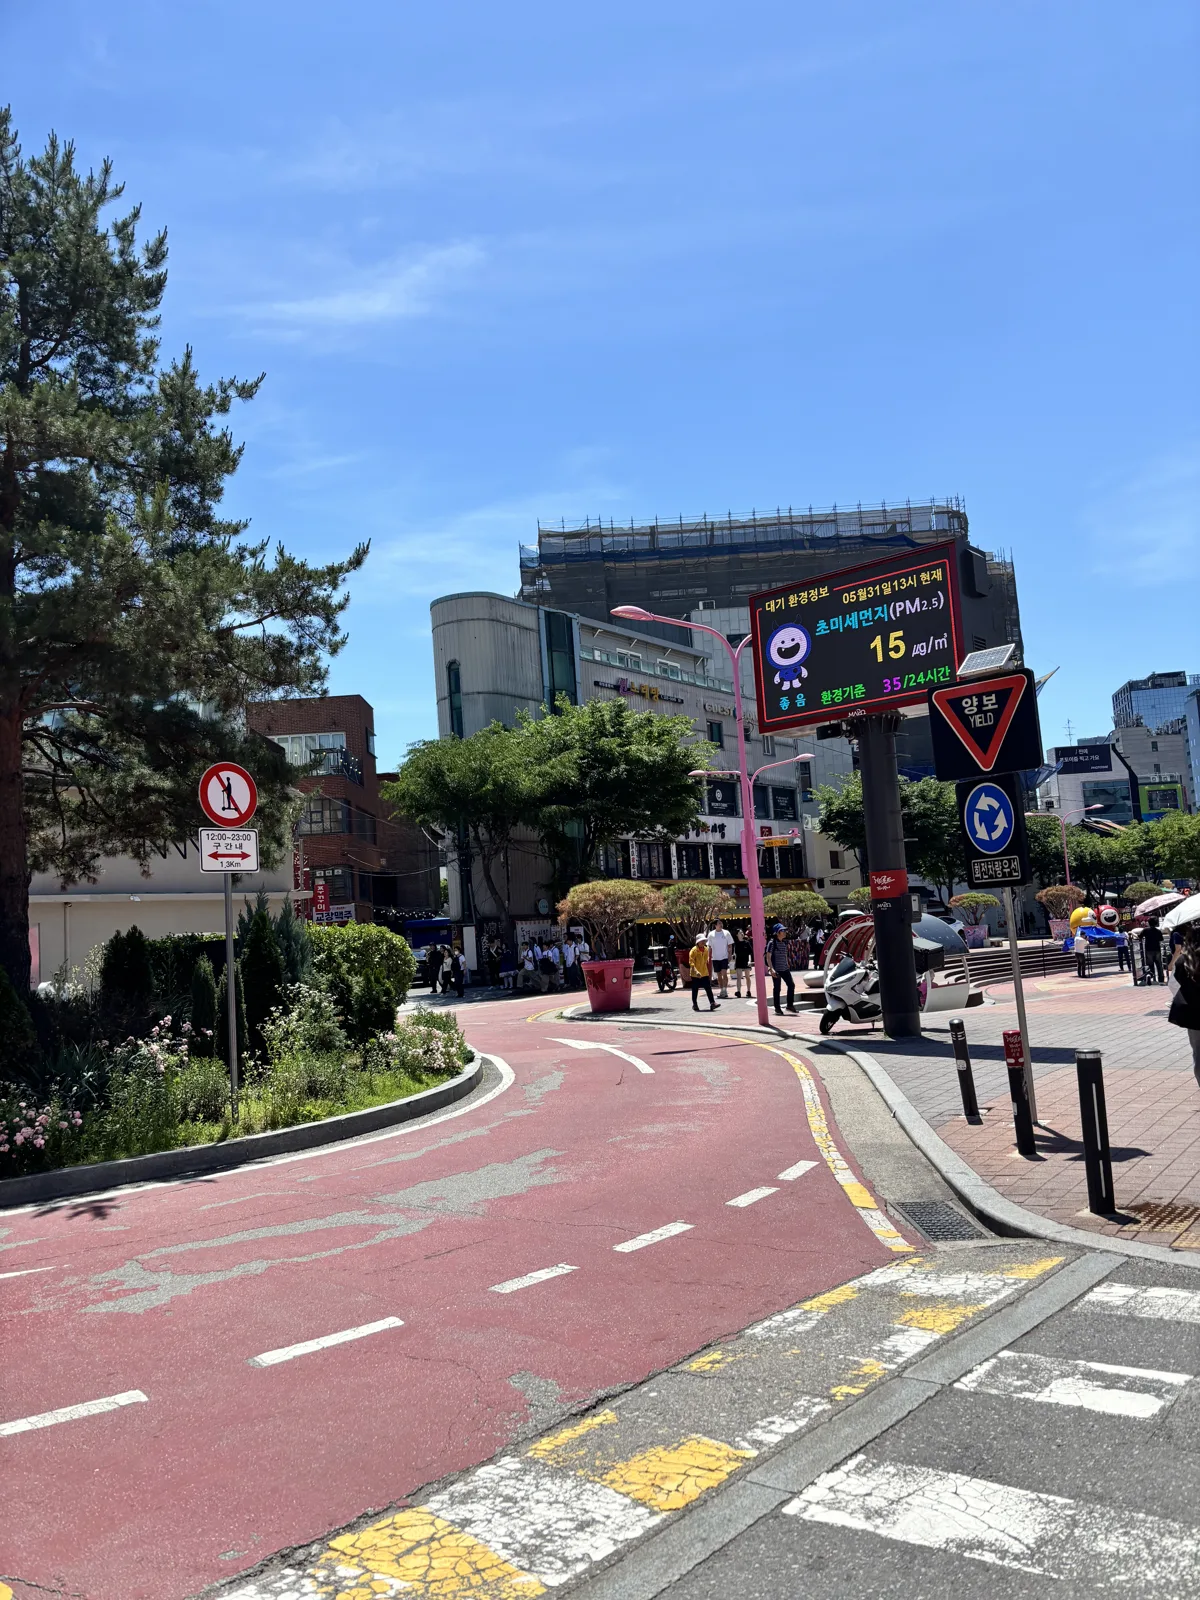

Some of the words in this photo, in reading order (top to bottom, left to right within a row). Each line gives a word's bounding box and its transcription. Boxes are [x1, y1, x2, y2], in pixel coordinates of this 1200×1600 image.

[842, 574, 917, 604] 05월31일13시
[919, 568, 943, 585] 현재
[765, 596, 785, 613] 대기
[788, 585, 829, 608] 환경정보
[870, 630, 906, 663] 15
[821, 684, 866, 706] 환경기준
[705, 702, 733, 716] GUEST
[969, 713, 994, 728] YIELD
[206, 833, 251, 841] 12:00~23:00
[220, 861, 241, 869] 1.3Km
[974, 859, 1019, 882] 회전차량우선
[315, 910, 353, 923] 교장맥주
